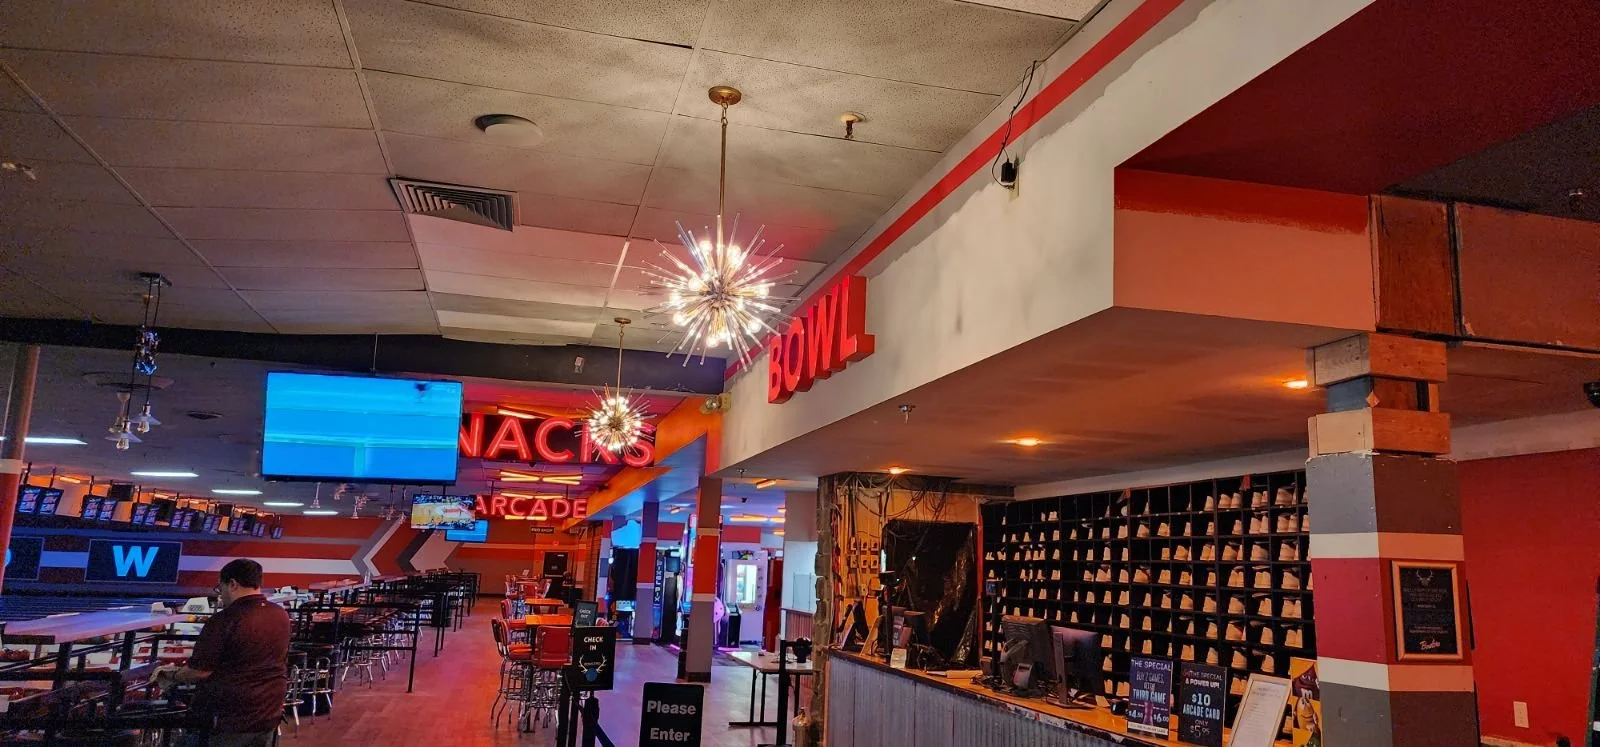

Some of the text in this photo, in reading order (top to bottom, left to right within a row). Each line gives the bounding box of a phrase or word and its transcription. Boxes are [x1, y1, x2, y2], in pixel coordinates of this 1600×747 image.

[768, 275, 875, 404] BOWL
[460, 412, 656, 467] NACKS
[475, 493, 587, 519] ARCADE
[113, 545, 159, 577] W
[1131, 659, 1172, 672] THE SPECIAL
[1190, 678, 1210, 687] POWER
[1132, 688, 1166, 704] THIRD GAME
[1192, 693, 1211, 706] $10
[647, 700, 697, 715] Please
[1182, 704, 1220, 720] ARCADE CARD
[649, 727, 691, 742] Enter
